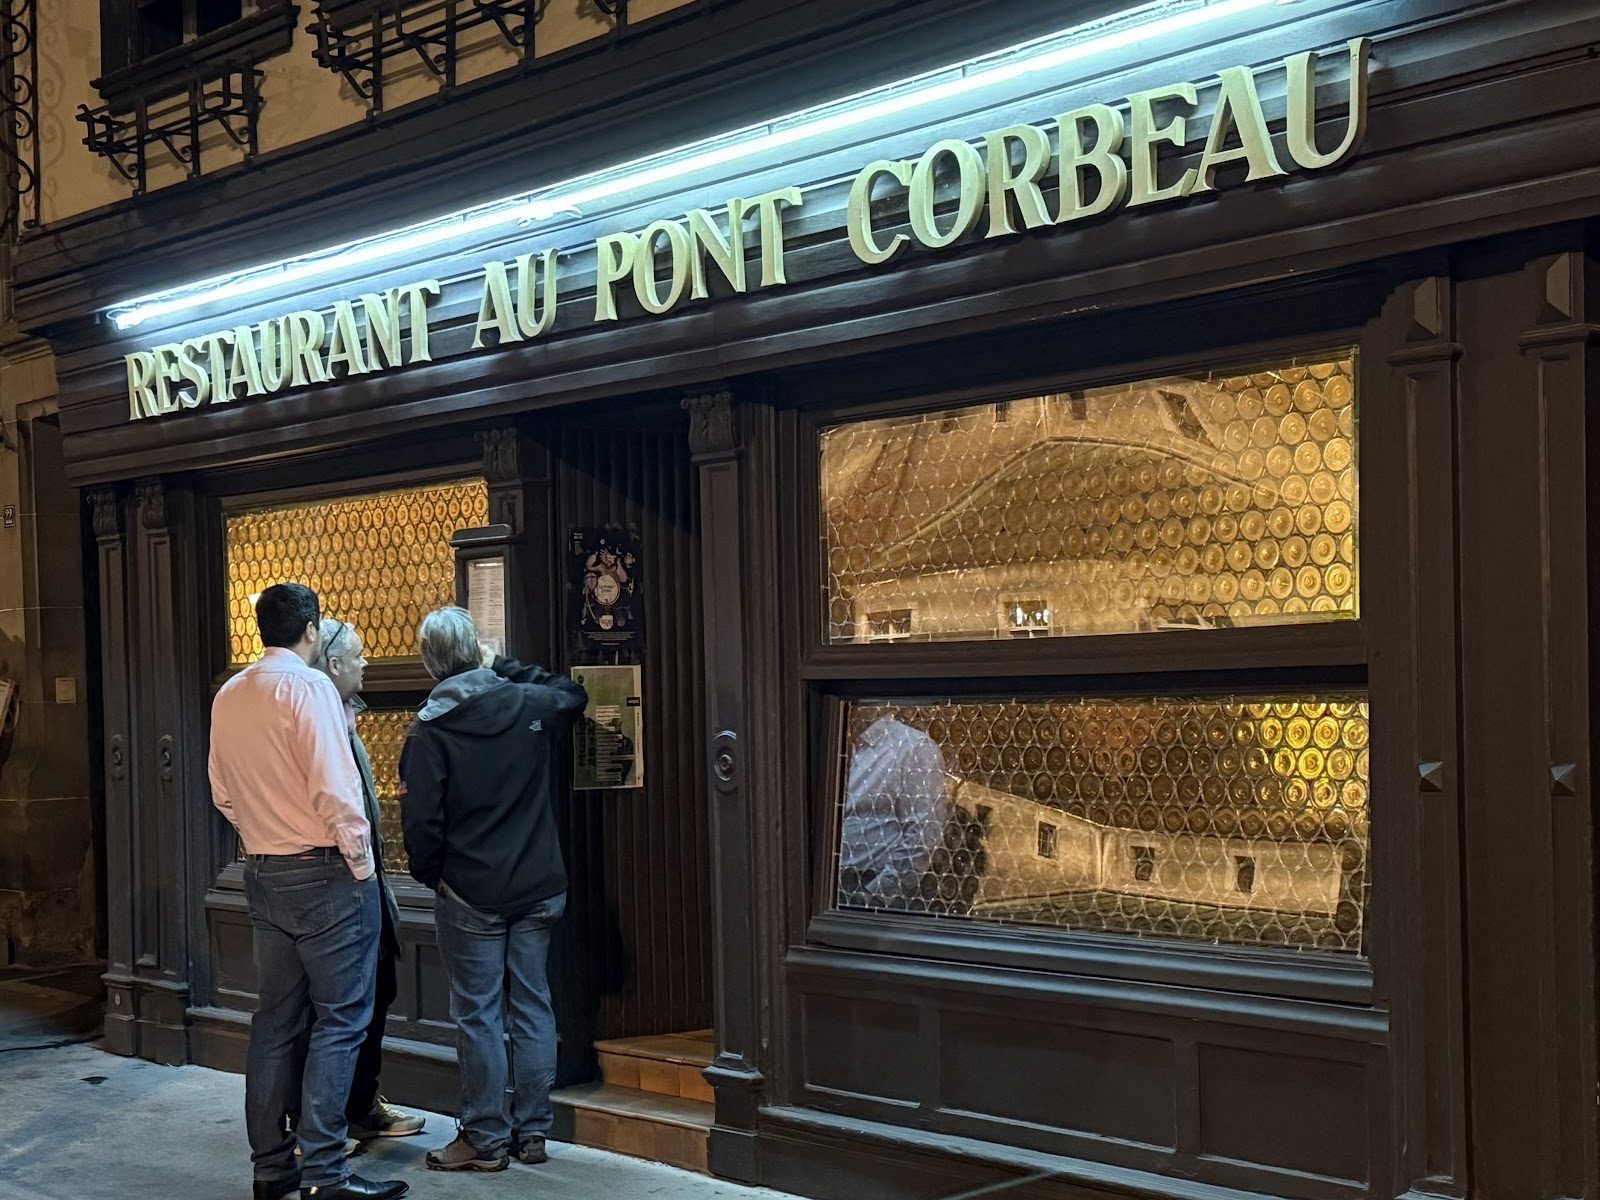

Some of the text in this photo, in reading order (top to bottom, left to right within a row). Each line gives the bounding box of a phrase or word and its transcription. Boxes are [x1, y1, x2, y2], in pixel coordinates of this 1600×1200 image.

[124, 37, 1373, 421] RESTAURANT AU PONT CORBEAU
